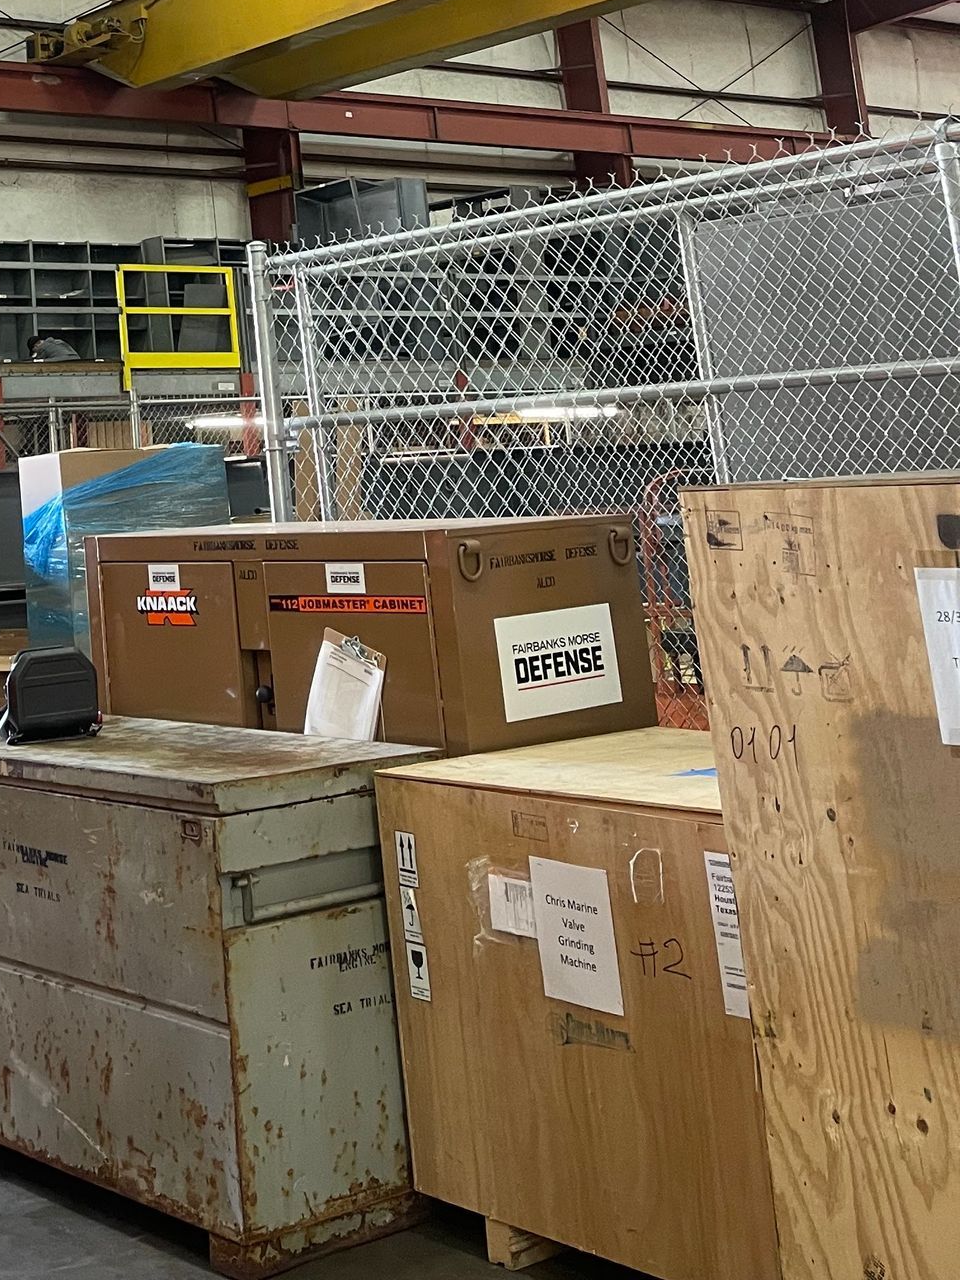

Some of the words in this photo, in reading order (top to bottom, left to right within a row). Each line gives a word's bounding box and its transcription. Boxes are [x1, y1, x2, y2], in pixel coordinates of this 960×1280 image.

[565, 545, 598, 561] DEFENSE
[152, 575, 176, 584] DEFENSE
[330, 575, 360, 584] DEFENSE
[137, 596, 197, 613] KNAACK
[281, 598, 299, 610] 112
[373, 599, 424, 611] CABINET
[511, 637, 567, 656] FAIRBANKS
[567, 631, 601, 646] MORSE
[514, 645, 606, 685] DEFENSE
[16, 882, 29, 894] SEA
[33, 886, 61, 903] TRIALS
[545, 894, 567, 909] Chris
[567, 900, 599, 916] Marine
[561, 916, 586, 933] Valve
[557, 935, 596, 956] Grinding
[560, 953, 597, 973] Machine
[629, 936, 693, 980] #2
[333, 1001, 353, 1016] SEA
